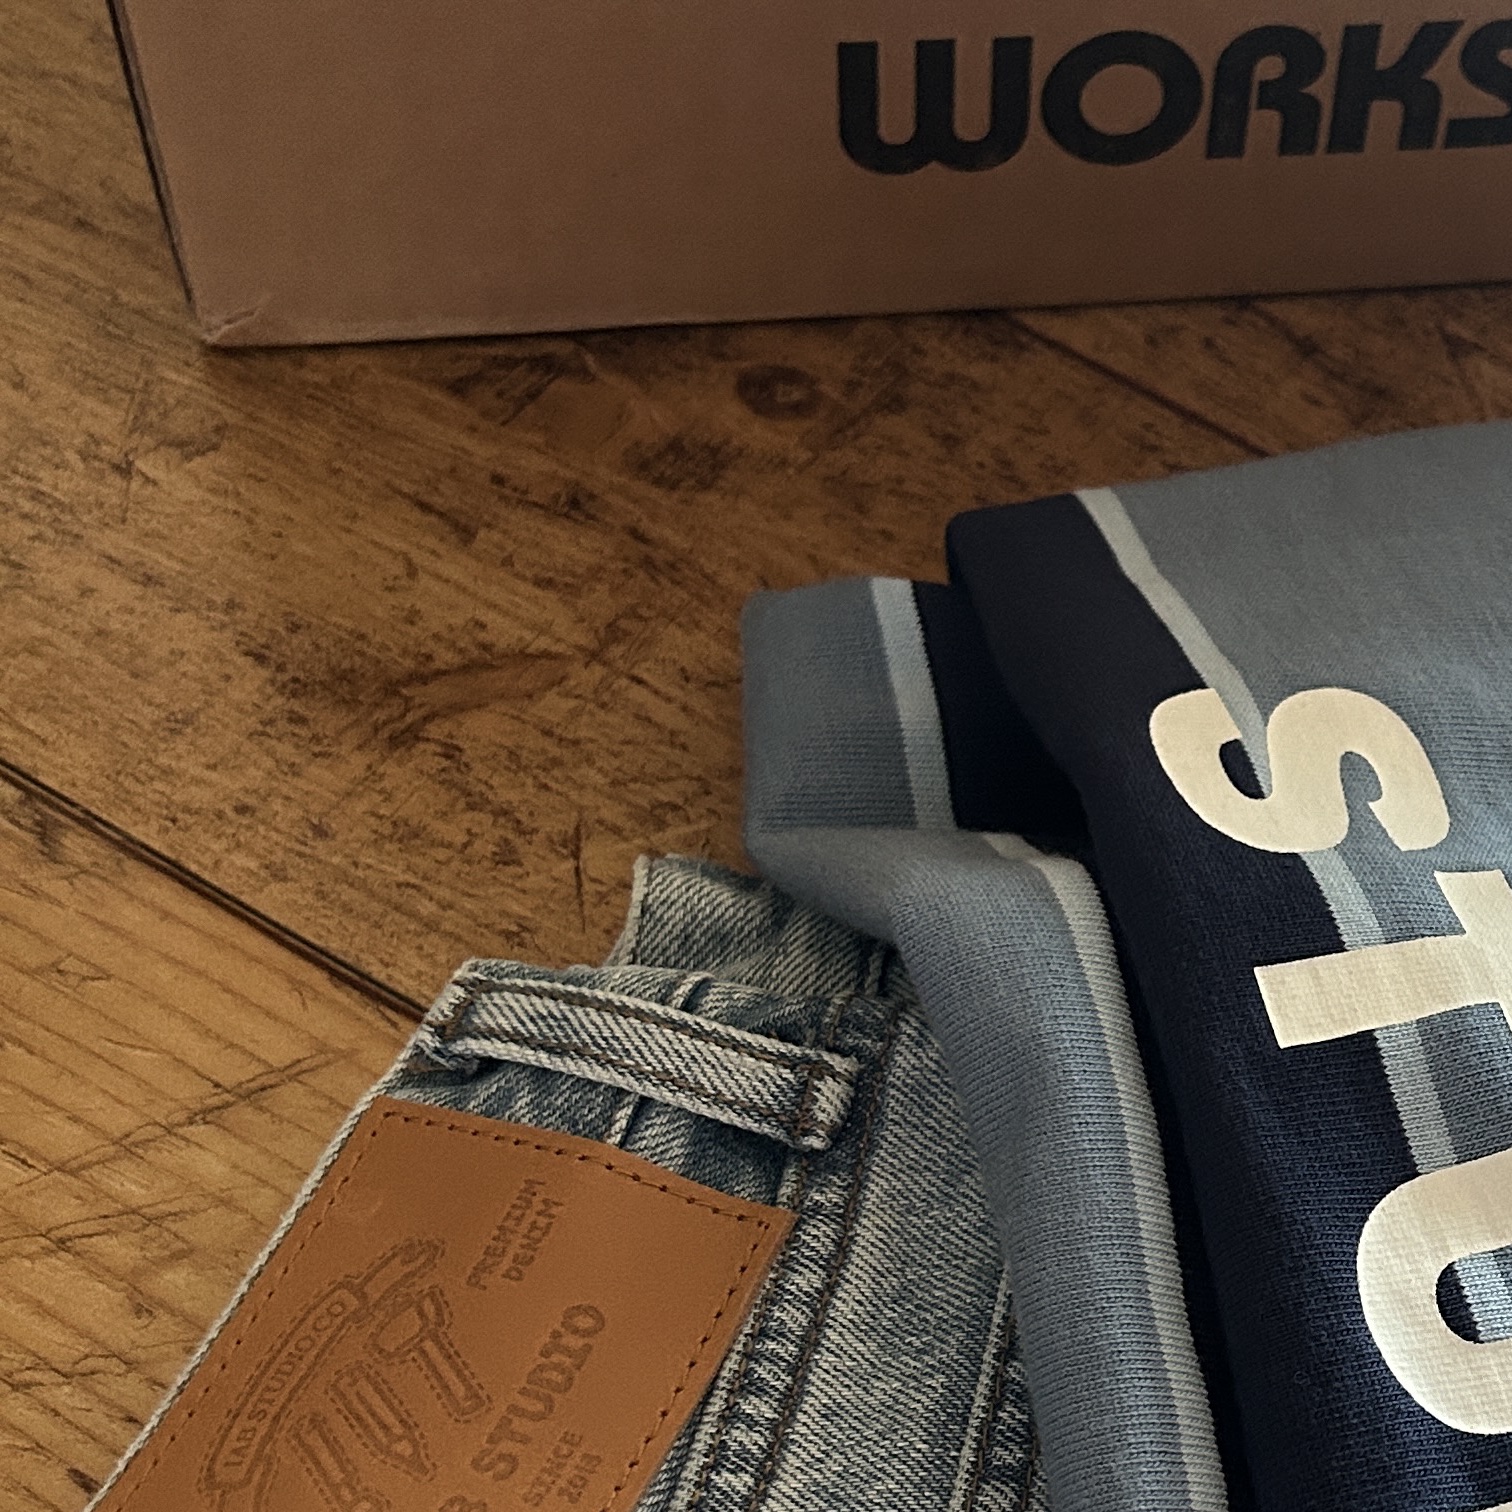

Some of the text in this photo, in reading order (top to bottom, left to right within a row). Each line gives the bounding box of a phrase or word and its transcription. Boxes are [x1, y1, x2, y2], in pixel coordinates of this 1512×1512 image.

[501, 1198, 564, 1281] DENIM
[470, 1304, 604, 1481] STUDIO
[522, 1430, 583, 1507] SINCE
